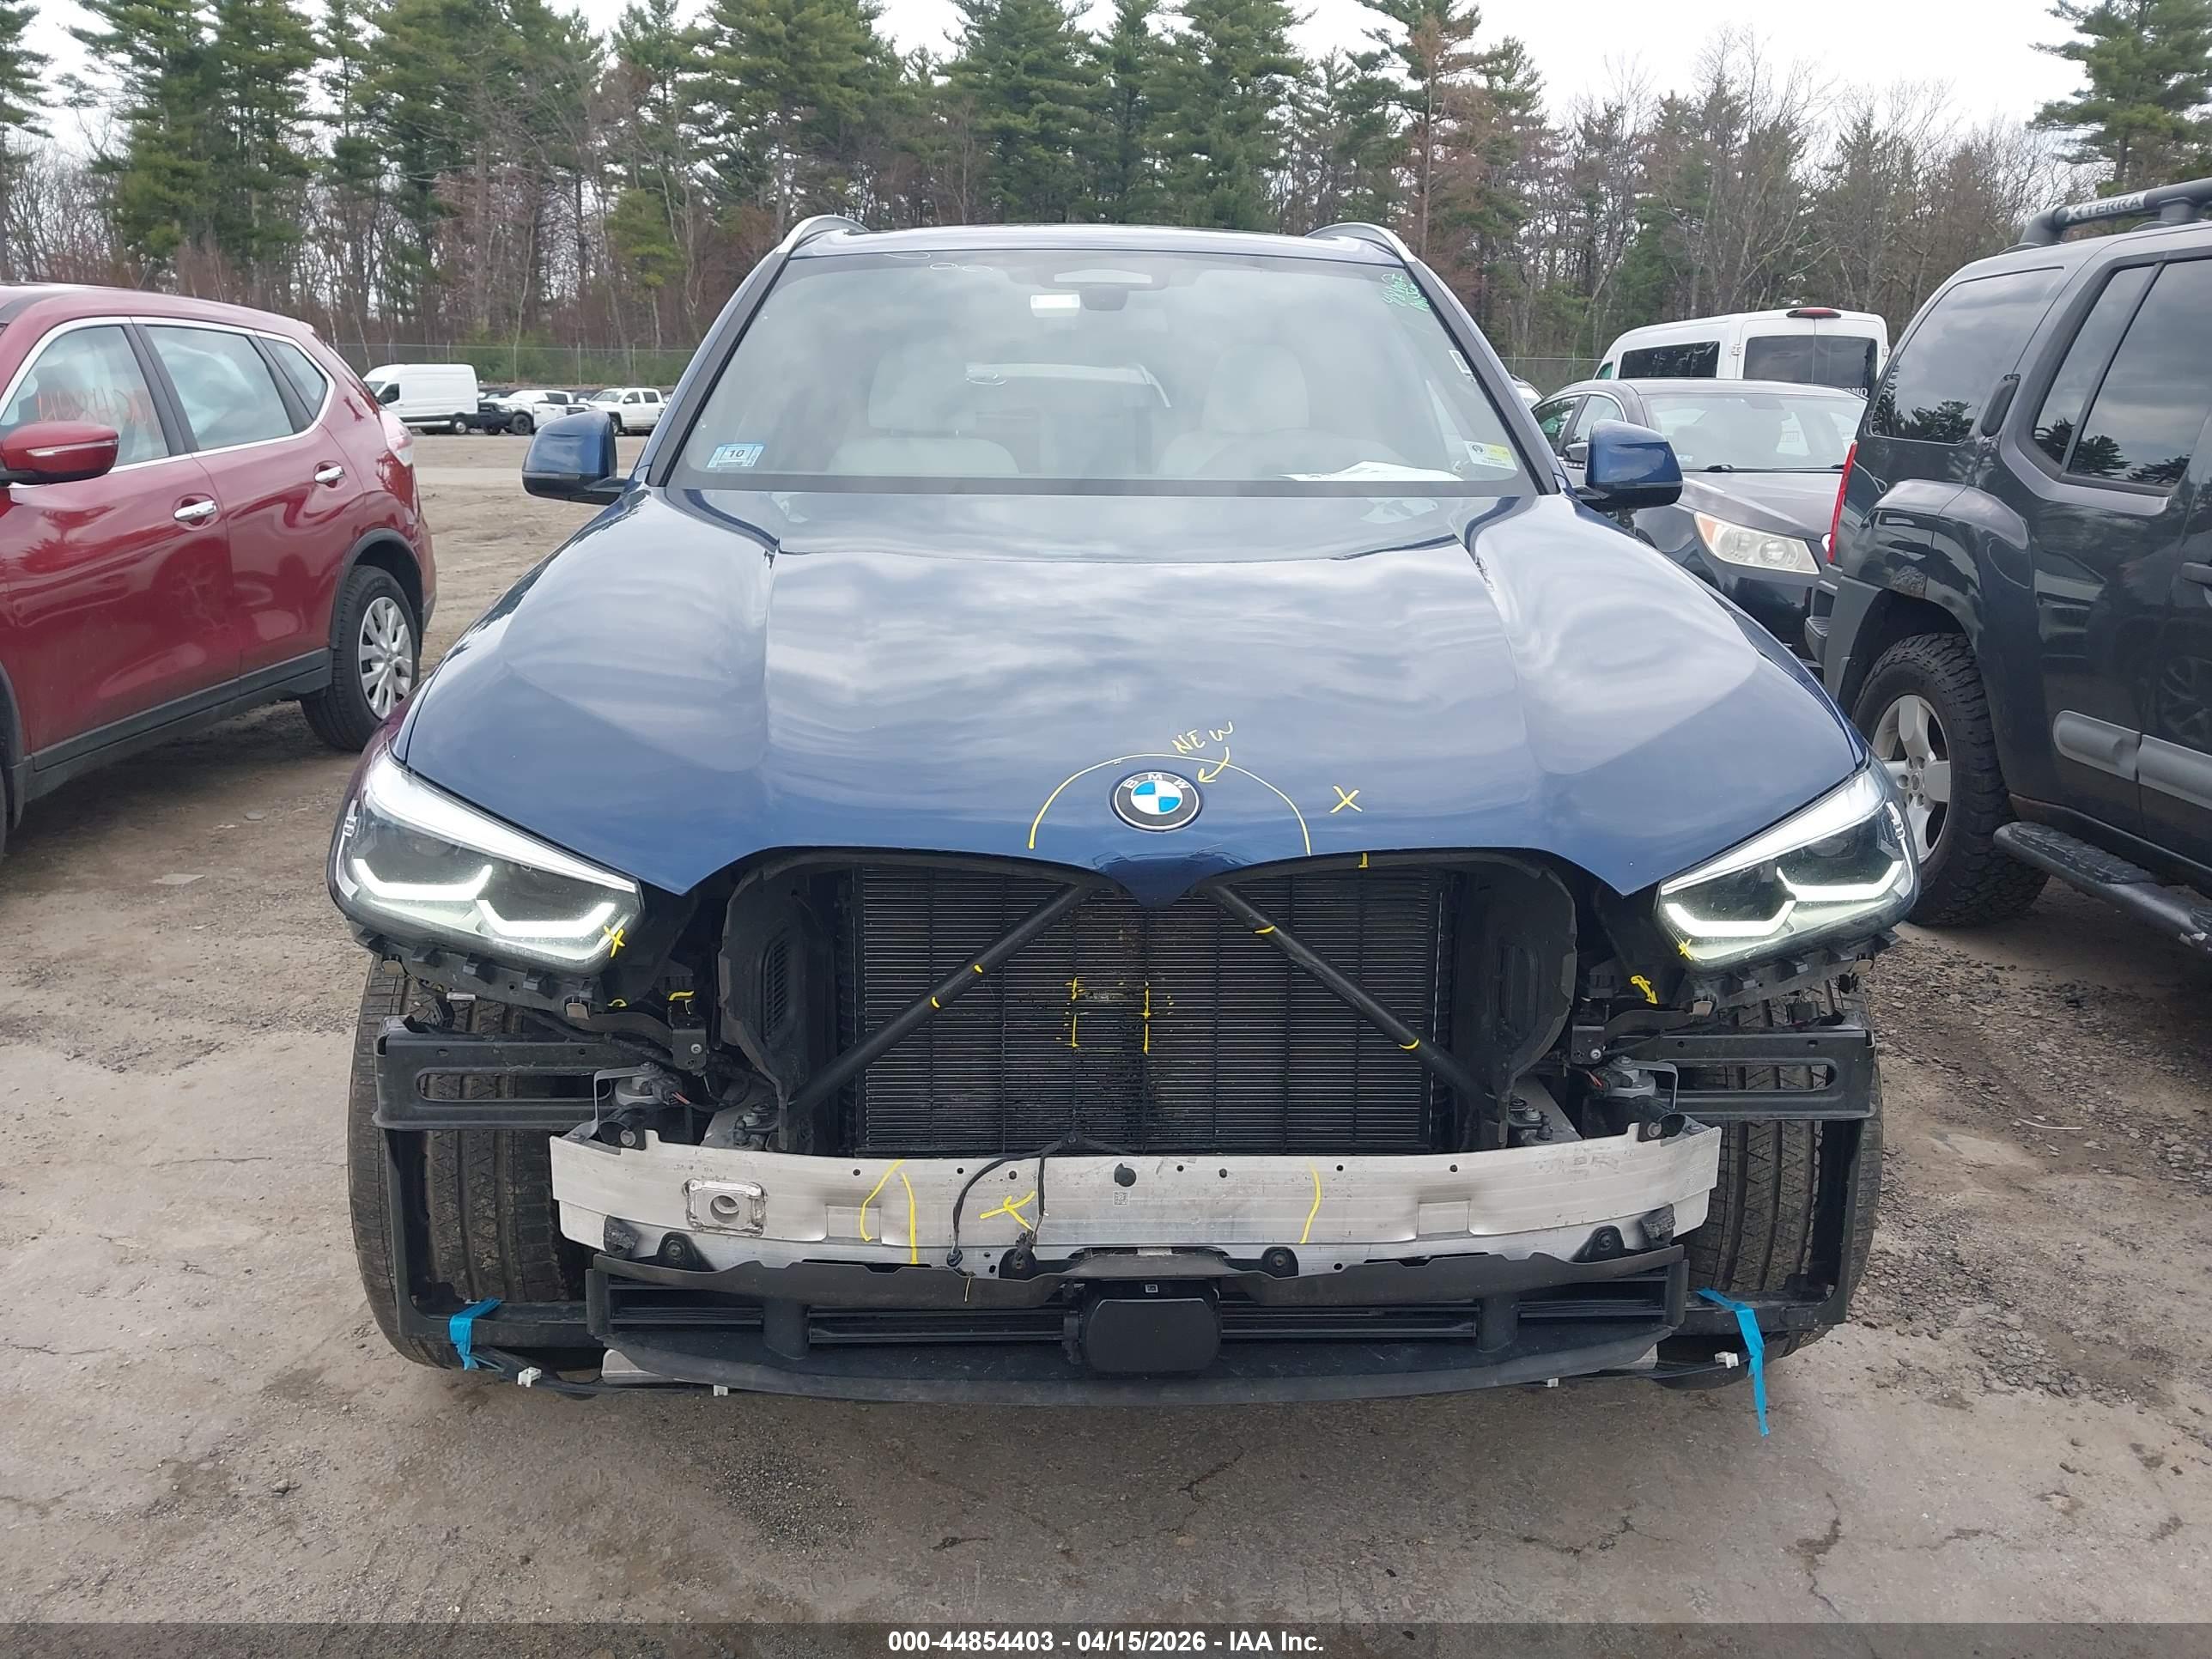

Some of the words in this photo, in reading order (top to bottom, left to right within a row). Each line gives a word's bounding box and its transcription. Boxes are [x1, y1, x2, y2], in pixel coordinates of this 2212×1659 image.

[2065, 196, 2142, 222] XTERRA
[729, 449, 745, 458] 10
[1171, 720, 1234, 754] NEW
[1123, 774, 1189, 789] BMW
